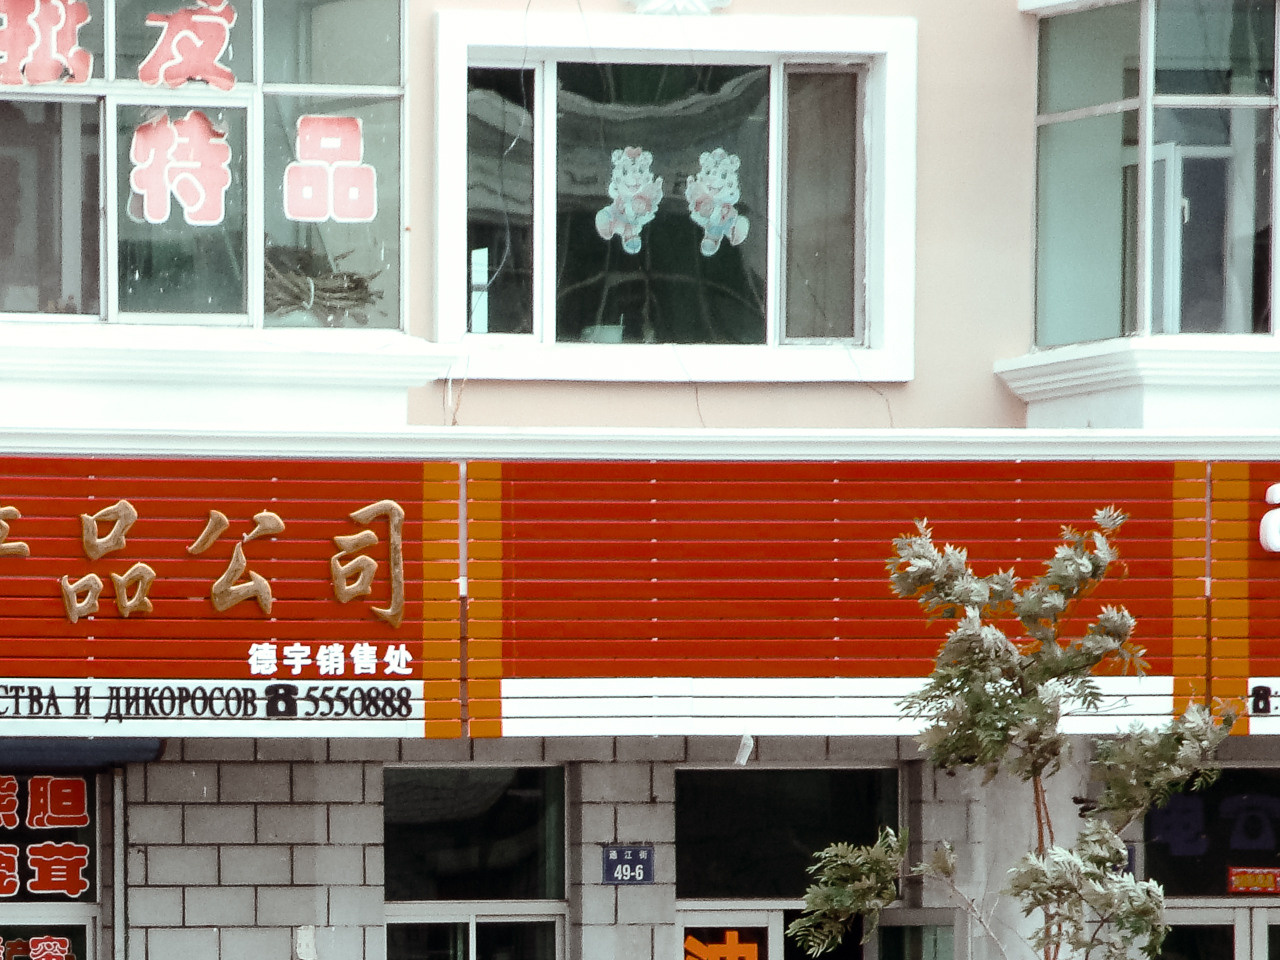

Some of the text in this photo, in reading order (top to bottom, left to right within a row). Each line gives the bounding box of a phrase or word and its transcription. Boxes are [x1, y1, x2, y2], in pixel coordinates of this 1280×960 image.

[247, 642, 413, 676] 德宇销售处
[73, 686, 92, 716] И
[104, 686, 258, 723] ДИКОРОСОВ
[304, 686, 413, 718] 5550888
[614, 864, 644, 880] 49-6
